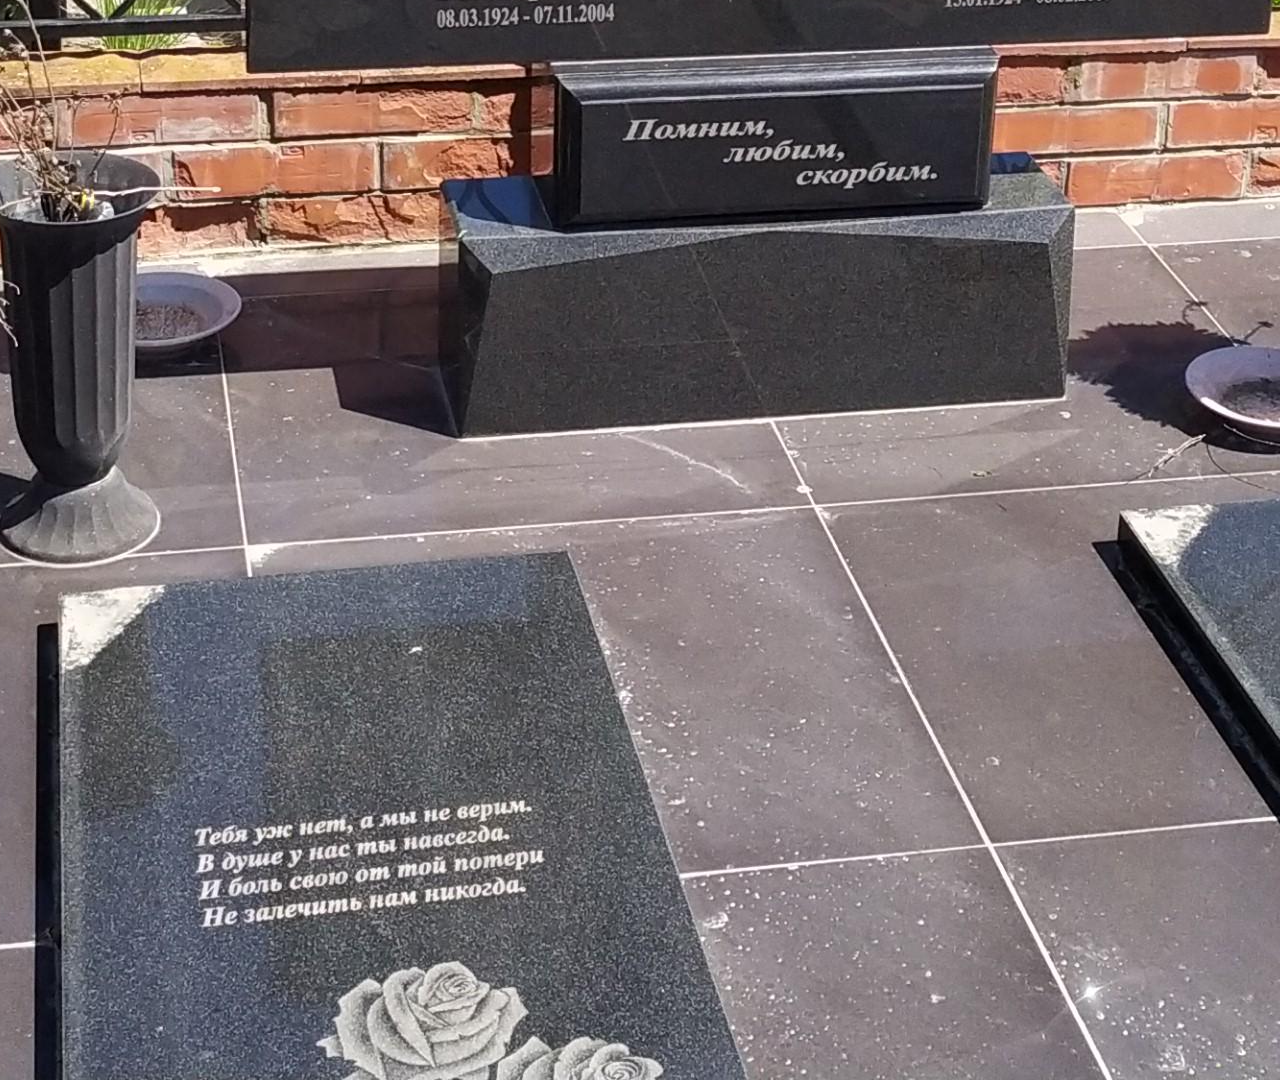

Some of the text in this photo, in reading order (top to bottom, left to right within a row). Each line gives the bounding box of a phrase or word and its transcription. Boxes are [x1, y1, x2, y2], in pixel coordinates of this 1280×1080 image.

[437, 6, 519, 29] 08.03.1924
[534, 3, 615, 25] 07.11.2004
[622, 118, 776, 143] Помним,
[722, 138, 847, 163] любим,
[796, 161, 939, 190] скорбим.
[195, 799, 533, 847] Тебя уж нет, а мы не верим.
[195, 825, 510, 874] В душе у нас ты навсегда.
[199, 848, 545, 900] И боль свою от той потери
[202, 877, 526, 927] Не залечить нам никогда.
